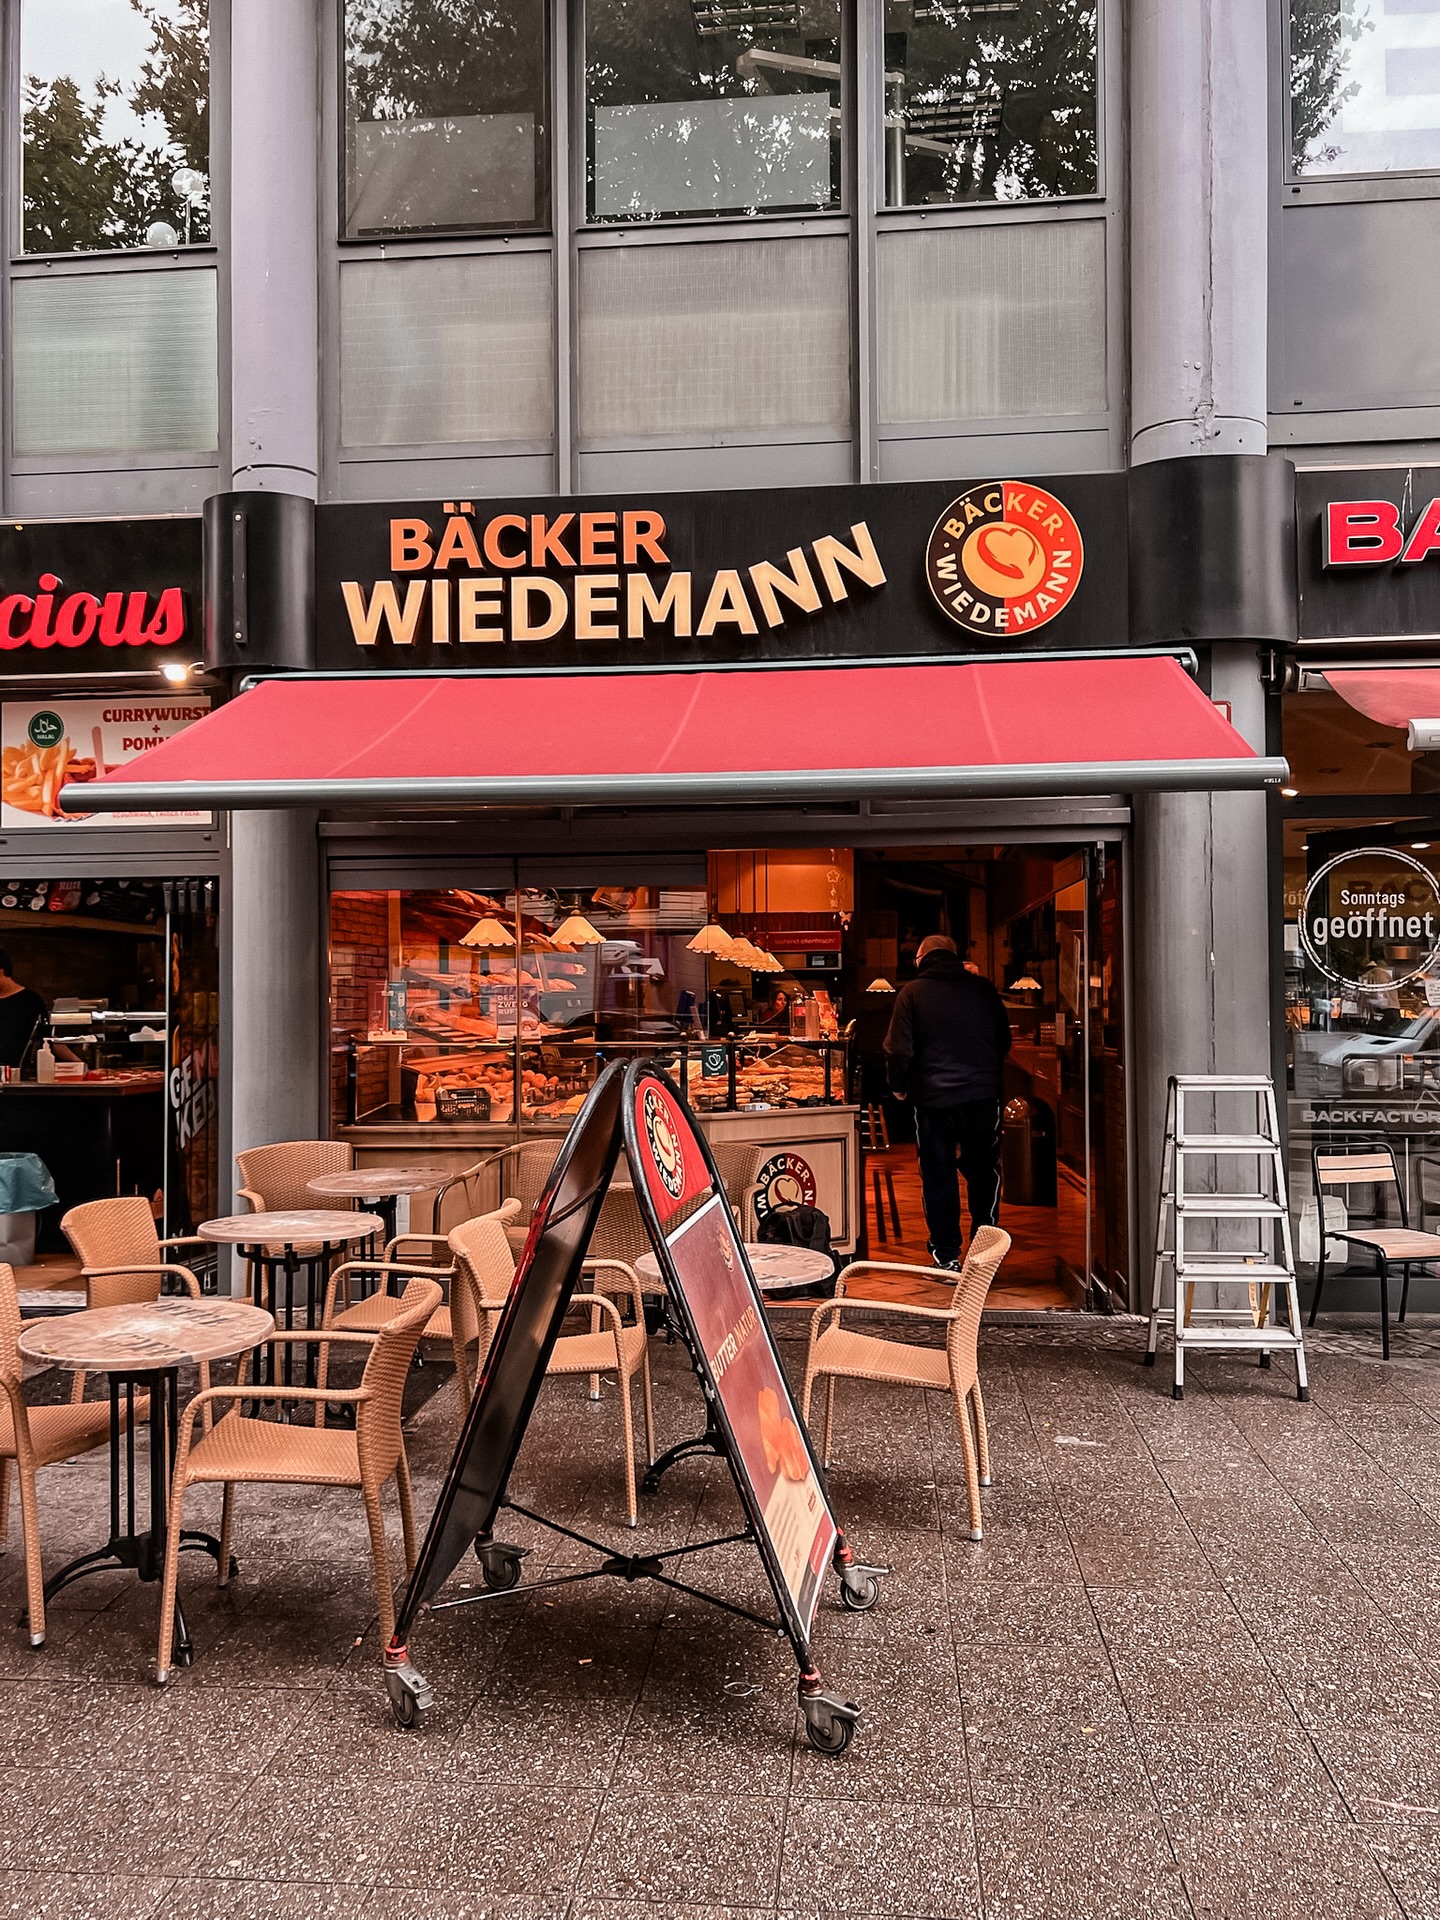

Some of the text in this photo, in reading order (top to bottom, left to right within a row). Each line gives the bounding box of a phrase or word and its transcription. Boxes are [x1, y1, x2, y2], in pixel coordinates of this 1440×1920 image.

[390, 502, 671, 572] BÄCKER
[943, 492, 1063, 539] BÄCKER
[0, 573, 185, 650] cious
[340, 521, 887, 645] WIEDEMANN
[936, 550, 1072, 627] WIEDEMANN
[103, 706, 212, 722] CURRYWURST
[1313, 907, 1434, 946] geöffnet
[1340, 889, 1406, 908] Sonntags
[760, 1157, 810, 1186] BÄCKER
[709, 1305, 758, 1385] BUTTER NATUR
